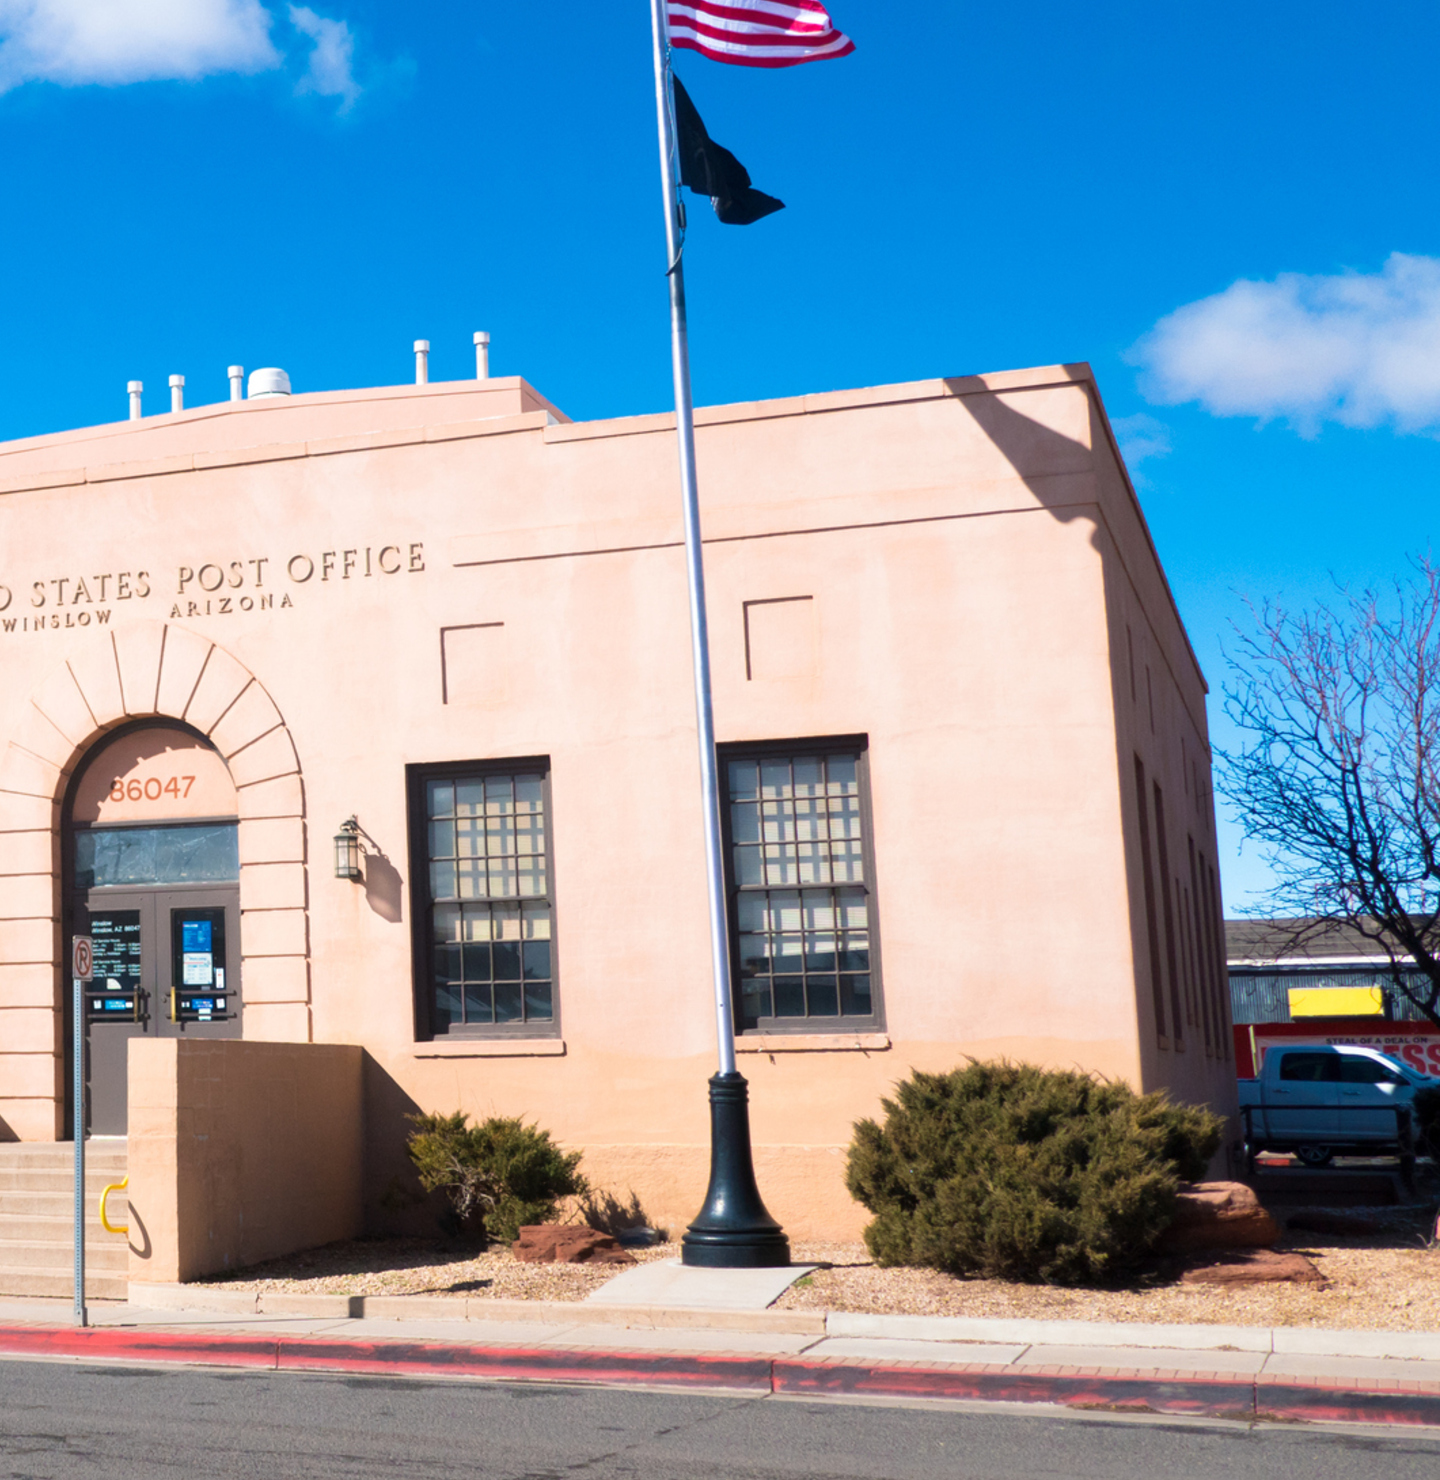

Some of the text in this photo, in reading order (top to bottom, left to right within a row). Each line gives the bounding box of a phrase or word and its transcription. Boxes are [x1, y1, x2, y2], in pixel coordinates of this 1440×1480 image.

[31, 571, 151, 608] STATES
[177, 557, 269, 594] POST
[287, 542, 426, 583] OFFICE
[2, 593, 294, 633] WINSLOW ARIZONA
[110, 775, 196, 802] 86047
